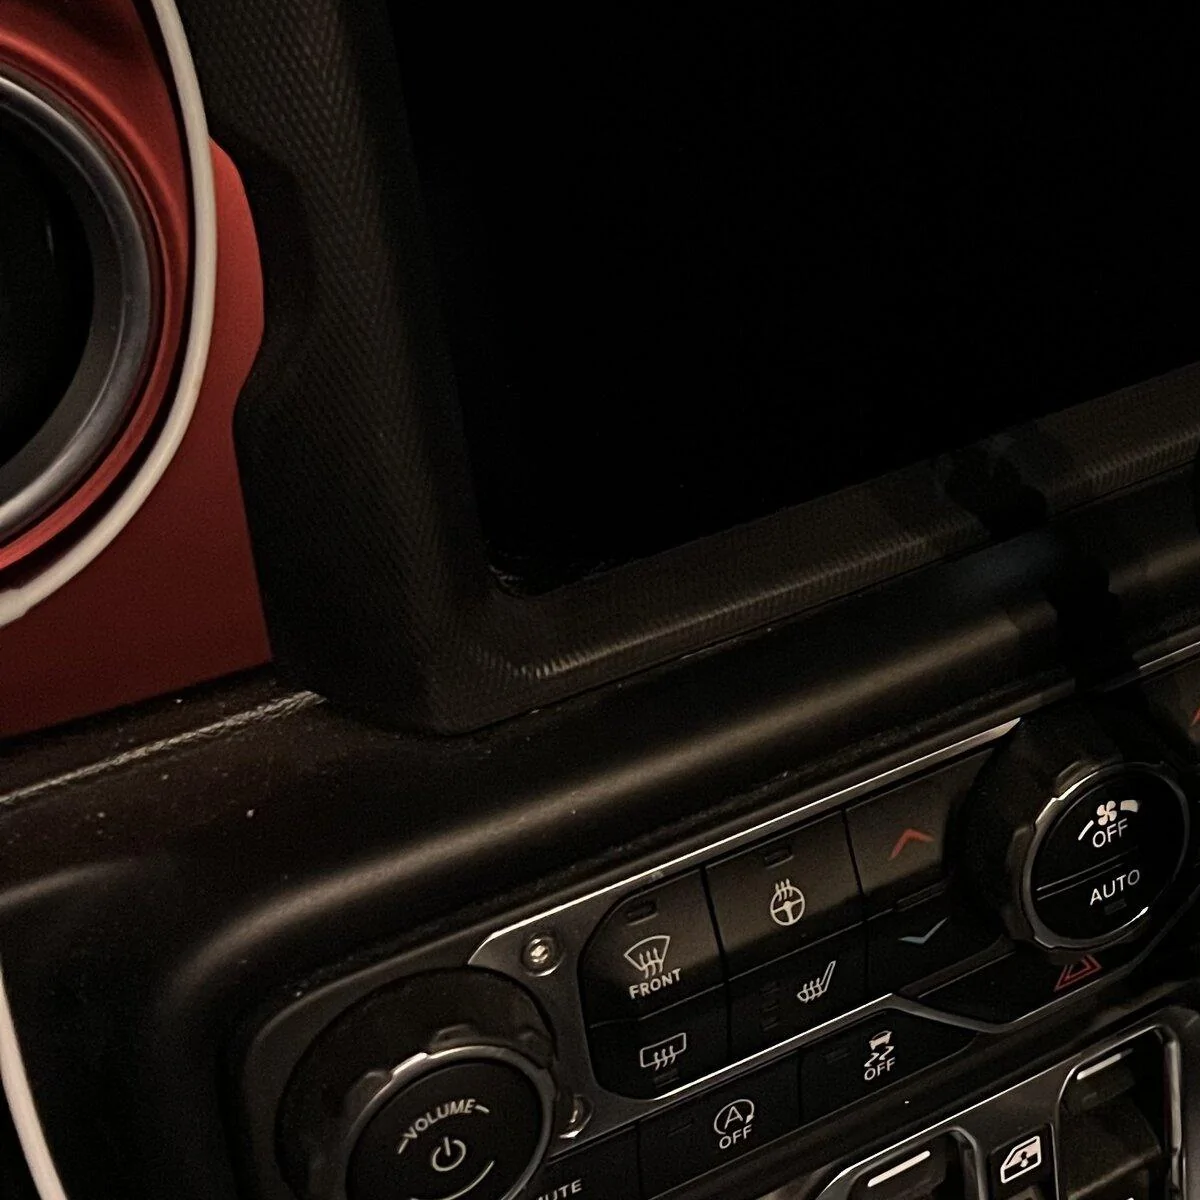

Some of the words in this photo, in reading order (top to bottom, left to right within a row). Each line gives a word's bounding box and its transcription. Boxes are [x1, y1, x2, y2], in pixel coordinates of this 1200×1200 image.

[1091, 818, 1129, 849] OFF
[1089, 869, 1141, 906] AUTO
[628, 967, 682, 1000] FRONT
[864, 1058, 896, 1081] OFF
[403, 1098, 476, 1140] VOLUME
[718, 1125, 752, 1150] OFF
[537, 1178, 583, 1200] UTE
